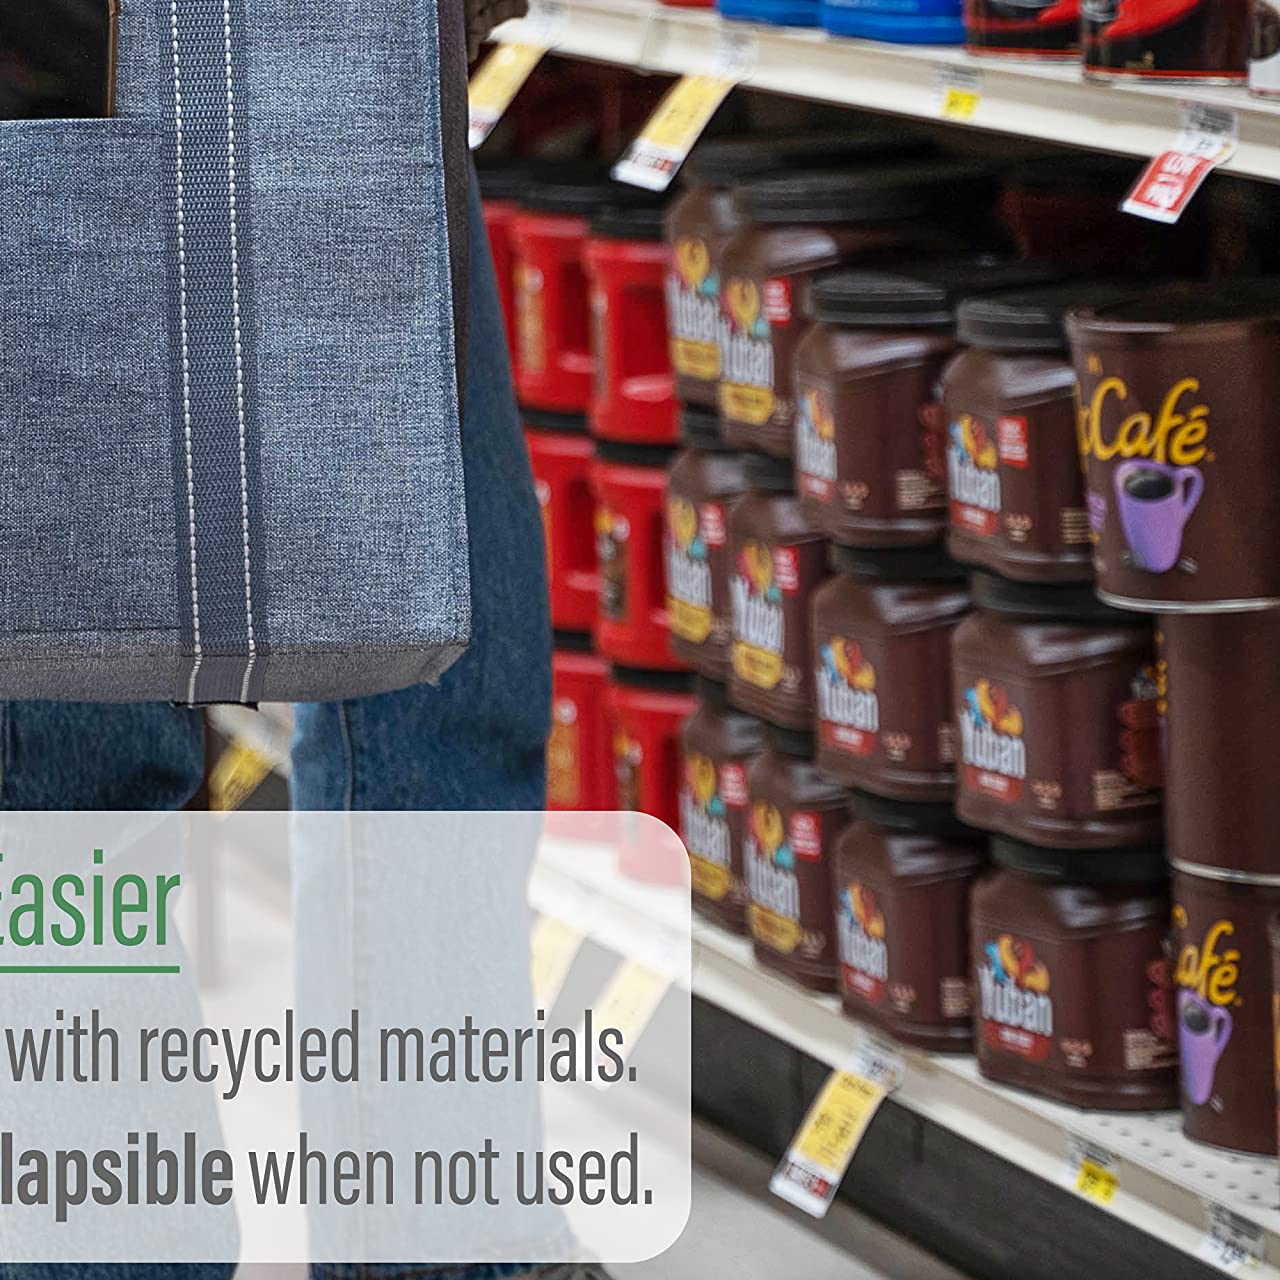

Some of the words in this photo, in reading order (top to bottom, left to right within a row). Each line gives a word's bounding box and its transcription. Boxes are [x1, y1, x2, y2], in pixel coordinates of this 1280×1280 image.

[958, 704, 1027, 780] Yuban
[1173, 907, 1241, 1006] afé
[977, 962, 1054, 1038] Yuban
